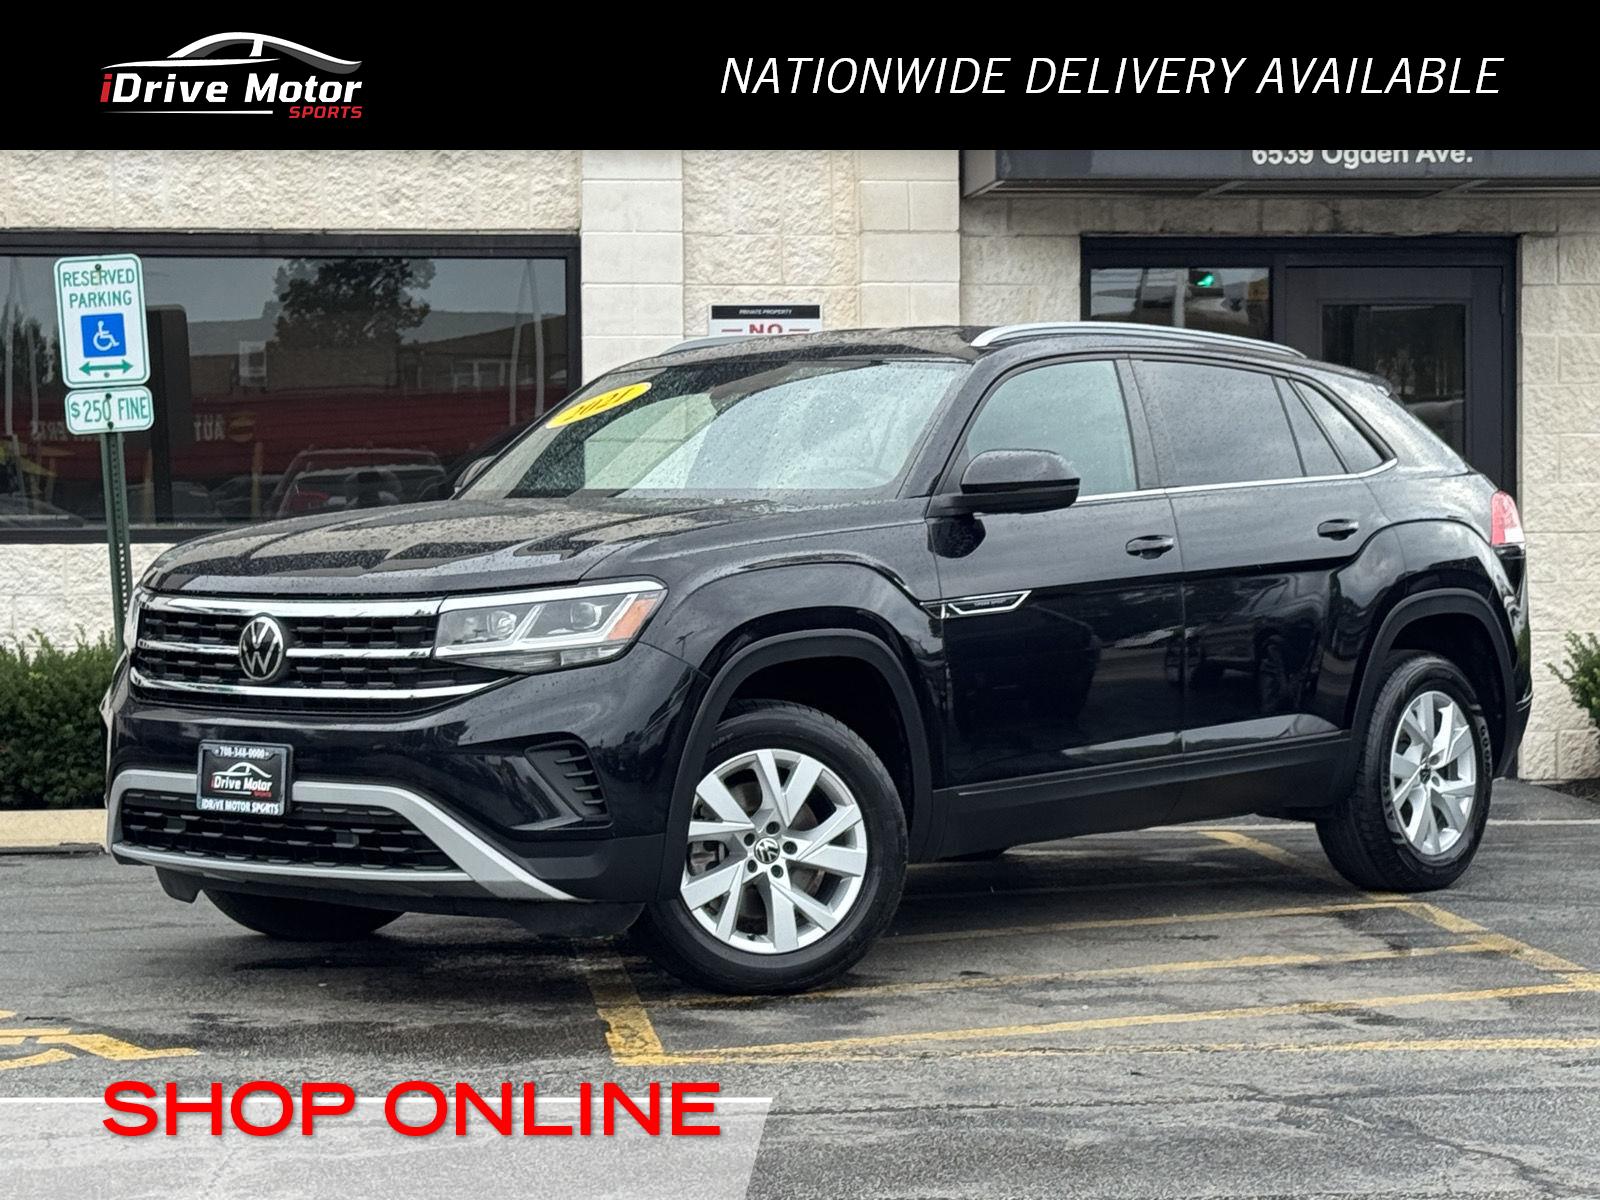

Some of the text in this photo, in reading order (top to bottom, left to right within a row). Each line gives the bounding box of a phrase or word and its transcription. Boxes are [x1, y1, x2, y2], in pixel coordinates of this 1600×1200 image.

[1251, 150, 1473, 169] 6539 Ogden Ave.
[63, 268, 135, 288] RESERVED
[69, 290, 132, 308] PARKING
[763, 308, 792, 316] PROPERTY
[748, 323, 783, 334] NO
[117, 396, 149, 420] FINE
